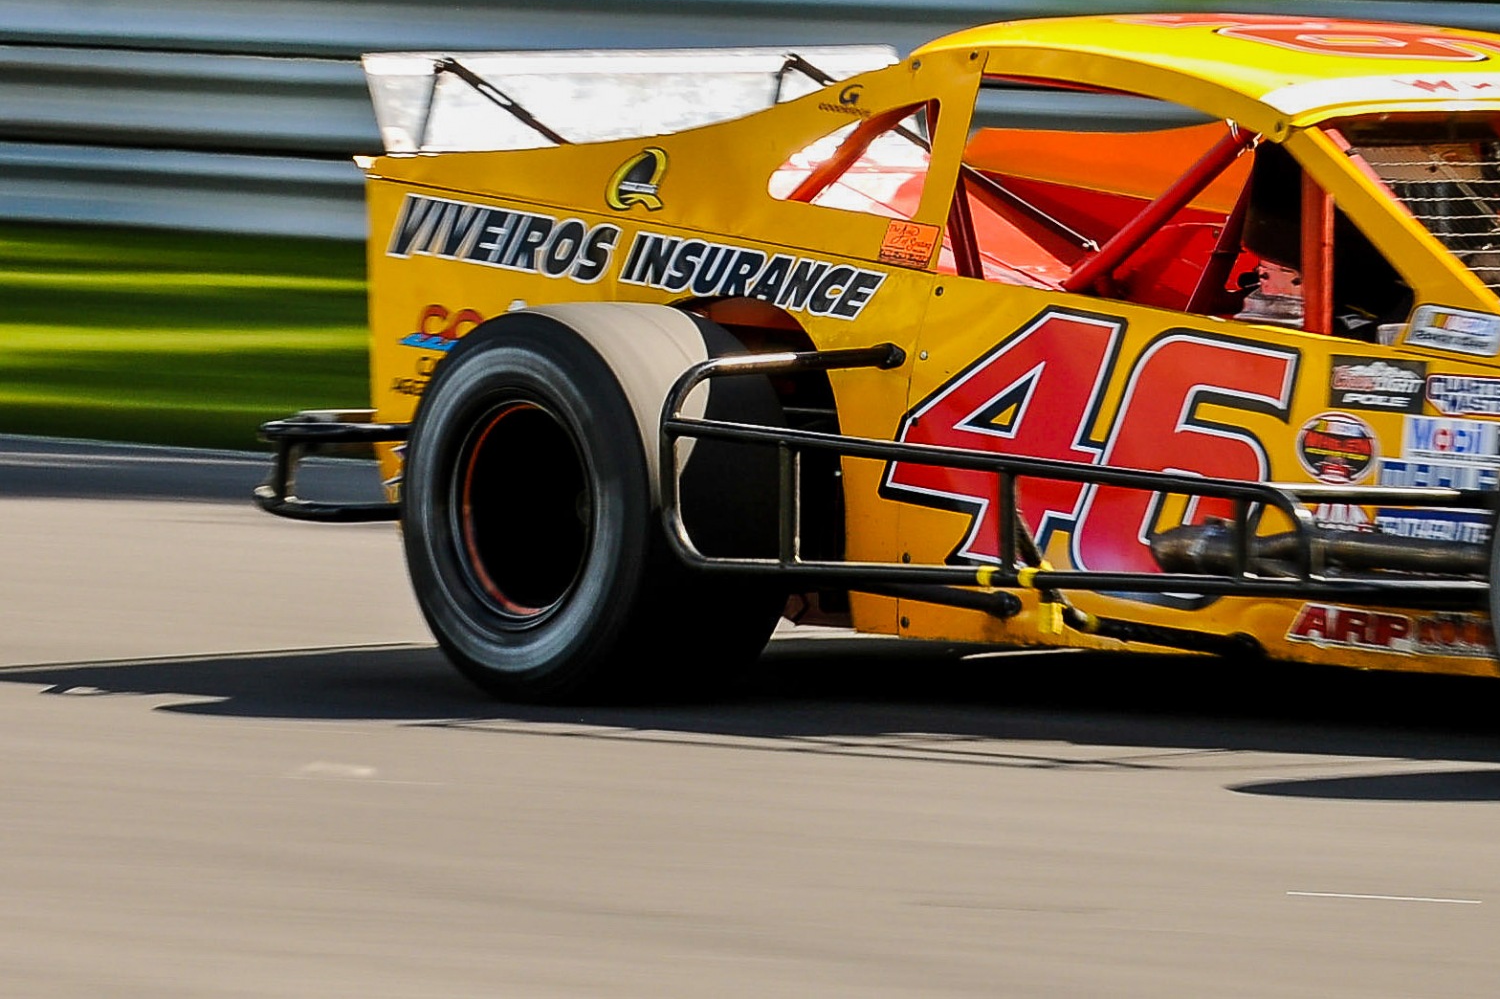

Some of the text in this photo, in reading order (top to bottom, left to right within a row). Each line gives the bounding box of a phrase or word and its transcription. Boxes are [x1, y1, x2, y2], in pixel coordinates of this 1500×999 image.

[387, 193, 622, 283] VIVEIROS
[618, 231, 888, 320] INSURANCE
[1342, 393, 1412, 407] POLE
[879, 305, 1300, 610] 46
[1288, 604, 1411, 650] ARP
